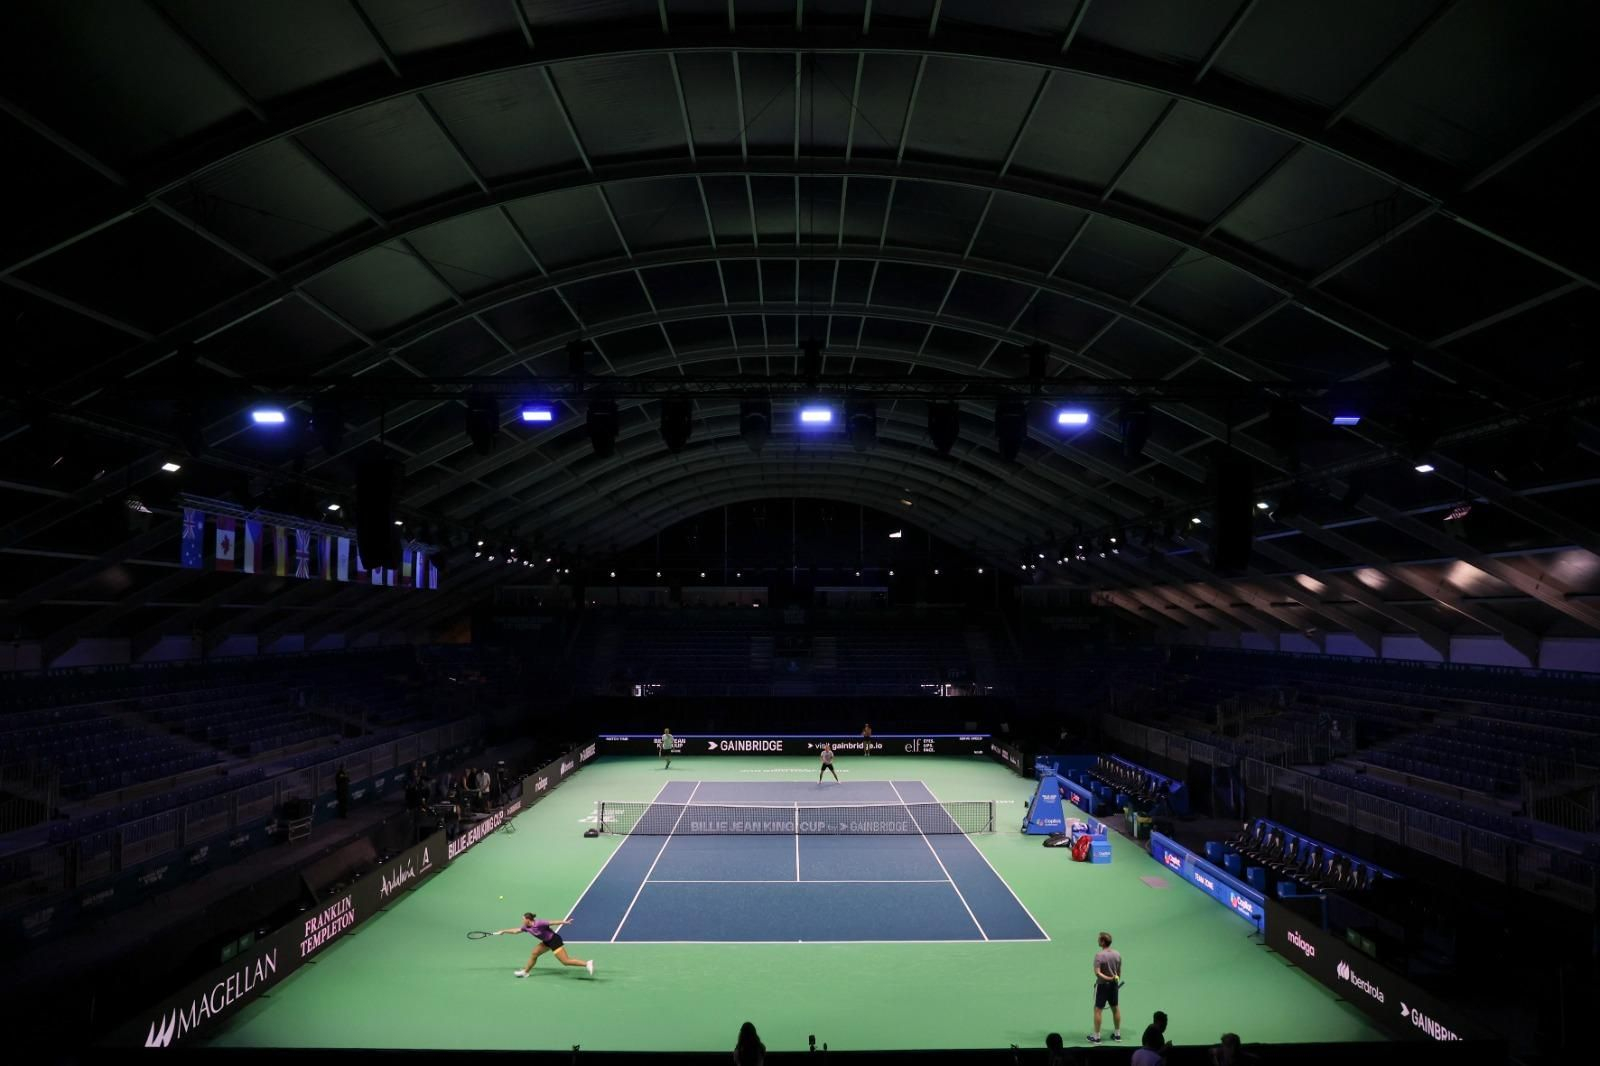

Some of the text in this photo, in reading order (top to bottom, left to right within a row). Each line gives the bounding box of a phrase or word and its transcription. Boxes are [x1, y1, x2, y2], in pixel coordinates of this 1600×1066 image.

[720, 740, 783, 751] GAINBRIDGE
[448, 811, 504, 860] BILLIE JEAN KING CUP
[690, 821, 728, 832] BILLIE
[730, 821, 762, 832] JEAN
[763, 821, 795, 832] KING
[800, 821, 825, 832] CUP
[849, 821, 909, 832] GAINBRIDGE
[300, 908, 355, 957] TEMPLETON
[304, 894, 351, 938] FRANKLIN
[1287, 930, 1316, 957] málaga
[177, 947, 278, 1039] MAGELLAN
[1350, 969, 1385, 1003] Iberdrola
[1411, 1007, 1463, 1041] GAINBRI
